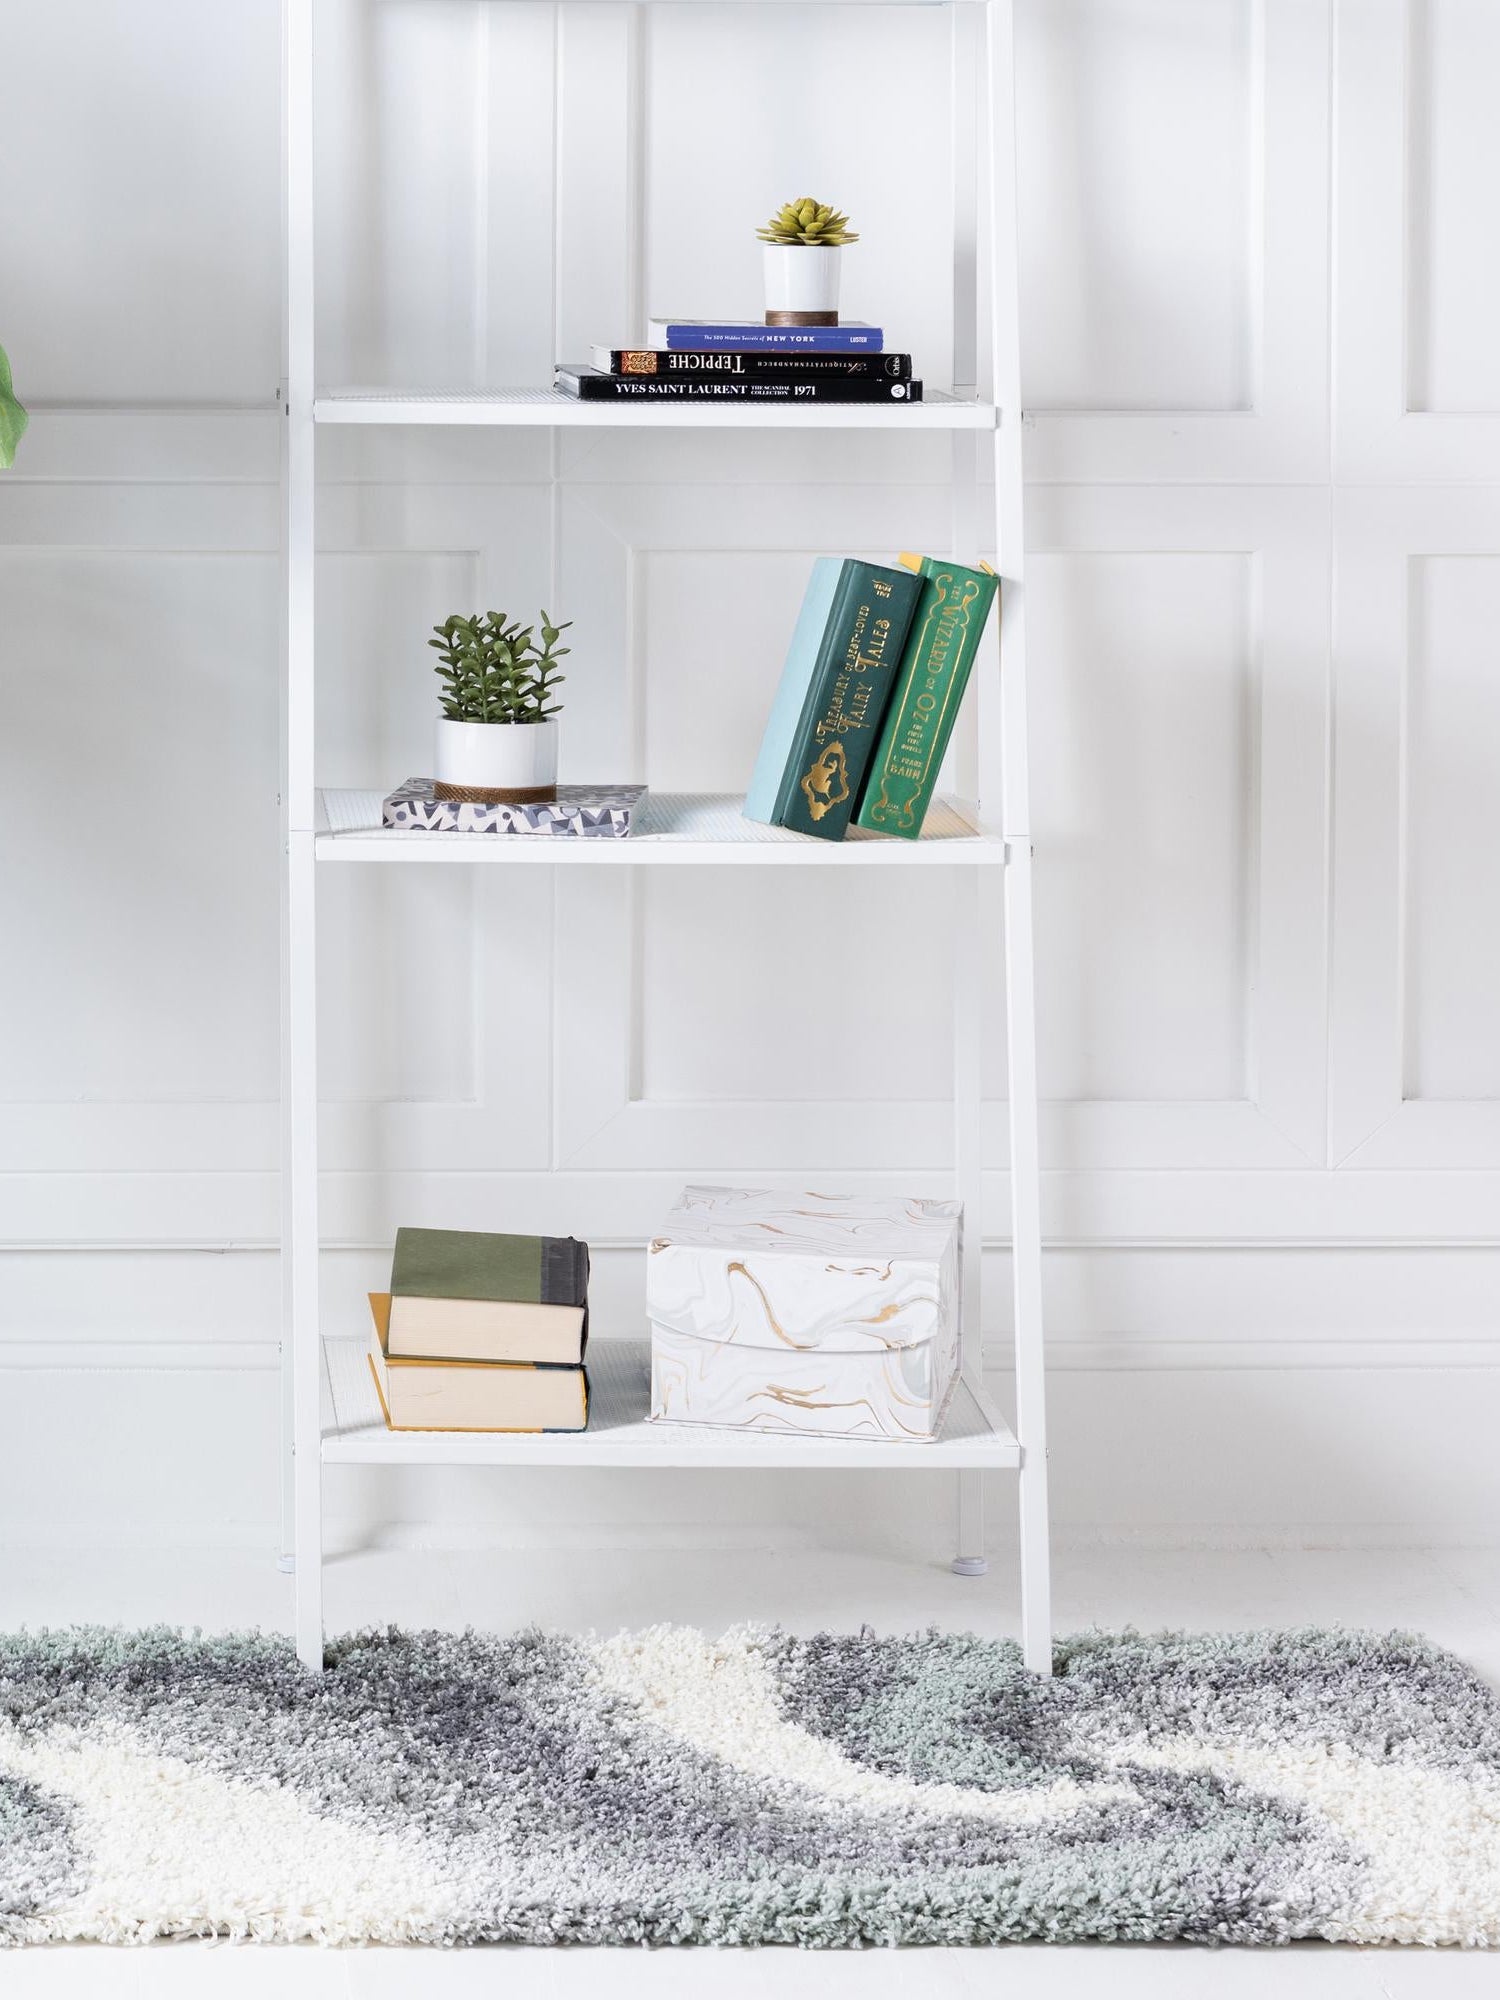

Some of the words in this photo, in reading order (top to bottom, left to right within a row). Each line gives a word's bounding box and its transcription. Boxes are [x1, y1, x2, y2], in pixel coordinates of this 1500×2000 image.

[669, 354, 746, 374] TEPPICHE
[615, 384, 646, 393] YVES
[648, 384, 686, 394] SAINT
[688, 384, 748, 394] LAURENT
[794, 385, 816, 396] 1971
[854, 619, 891, 673] TALES
[927, 605, 962, 674] WIZARD
[816, 673, 850, 736] TREASURY
[846, 605, 870, 660] BEST-LOVED
[837, 682, 873, 734] FAIRY
[912, 692, 937, 723] OZ
[890, 763, 921, 780] BAUM
